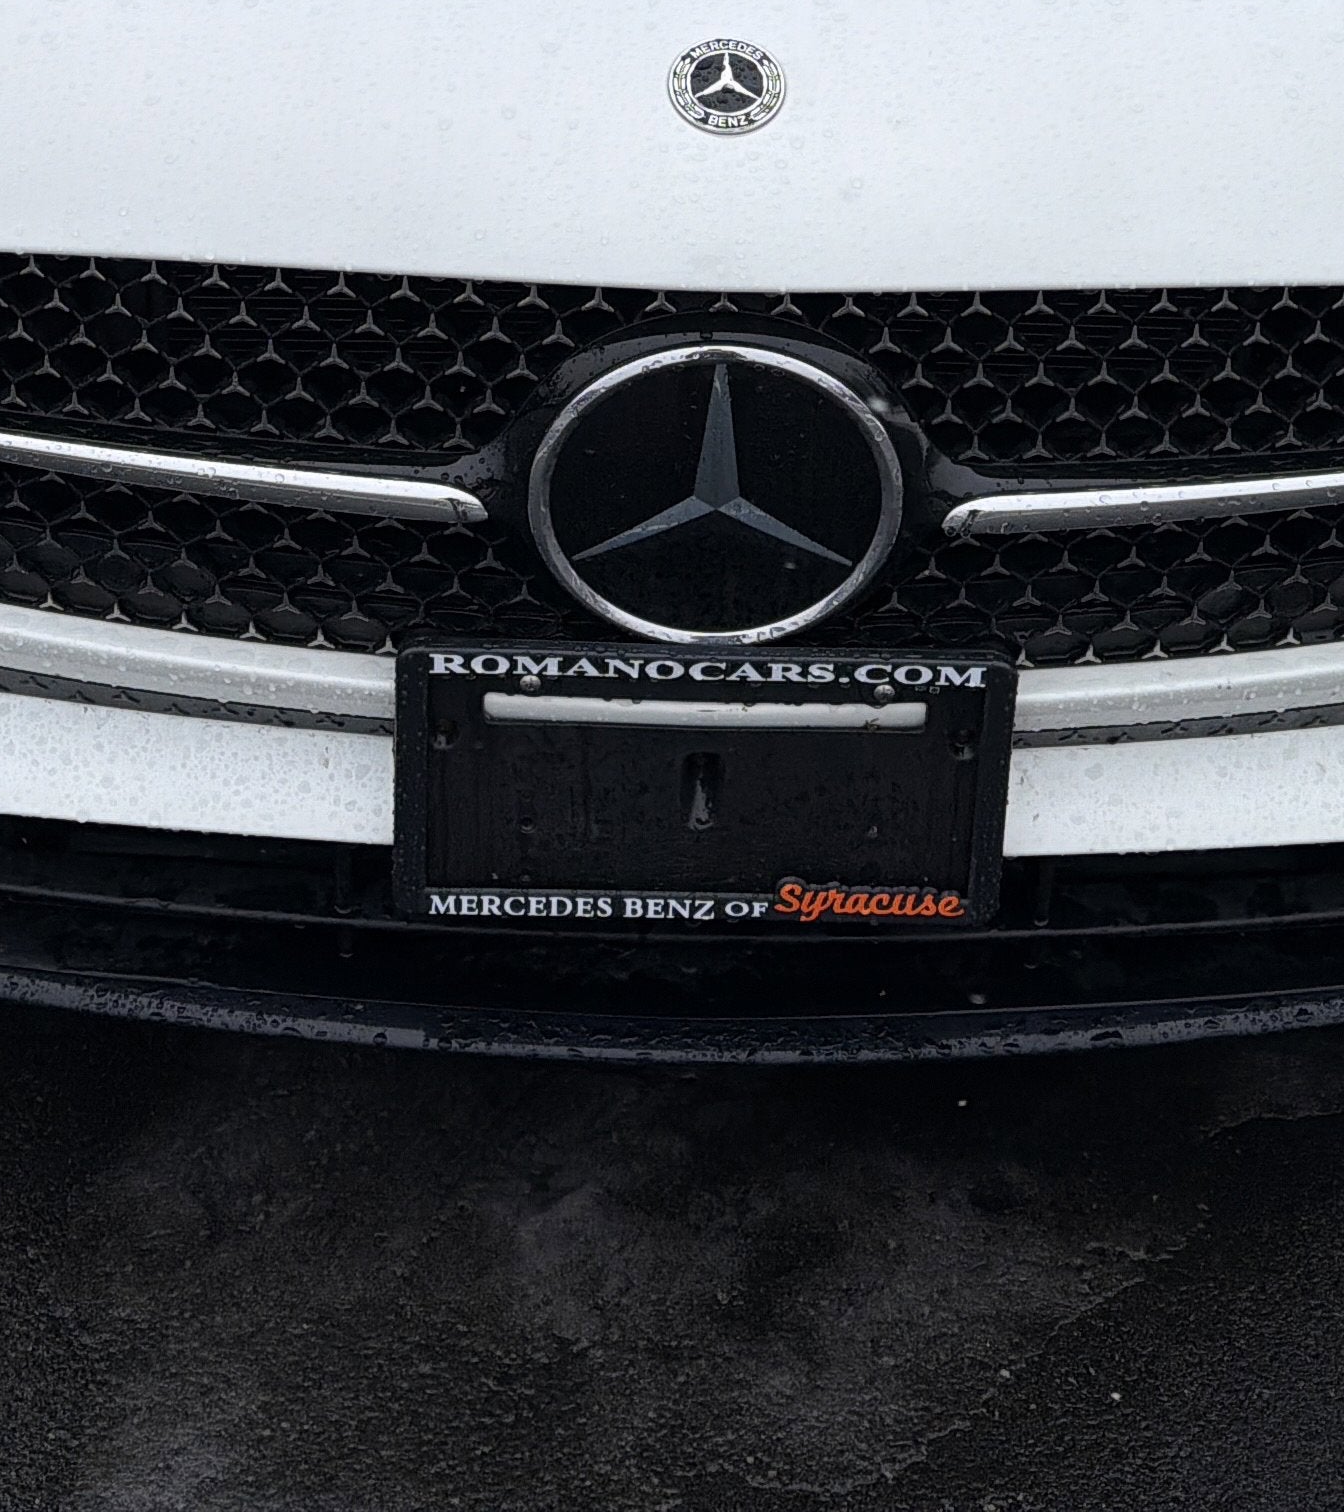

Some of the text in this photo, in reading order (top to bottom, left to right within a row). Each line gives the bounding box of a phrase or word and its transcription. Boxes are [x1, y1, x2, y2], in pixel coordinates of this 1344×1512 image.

[690, 40, 763, 60] MERCEDES
[708, 115, 748, 127] BENZ
[428, 653, 988, 688] ROMANOCARS.COM
[427, 882, 965, 923] MERCEDES BENZ OF Syracuse
